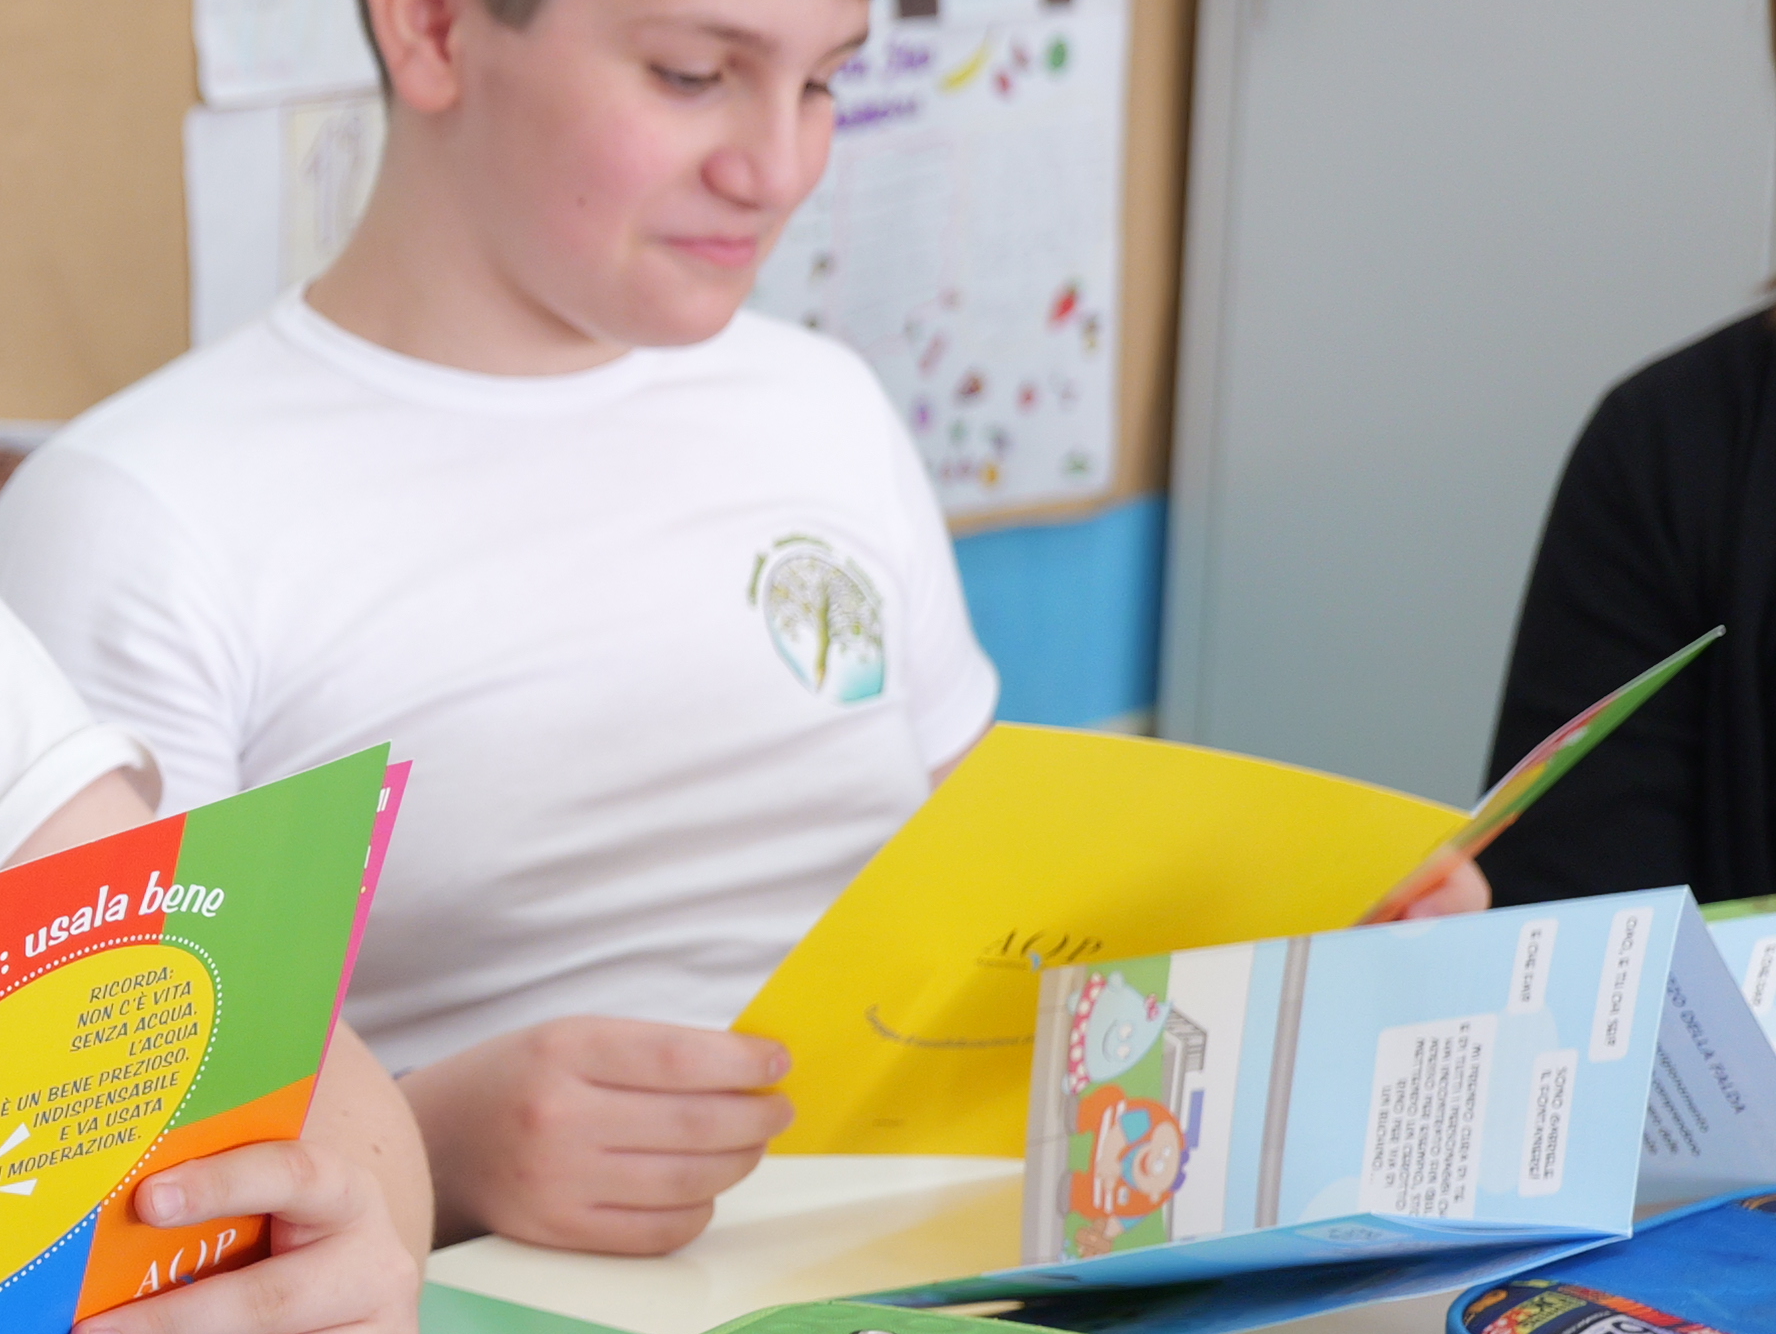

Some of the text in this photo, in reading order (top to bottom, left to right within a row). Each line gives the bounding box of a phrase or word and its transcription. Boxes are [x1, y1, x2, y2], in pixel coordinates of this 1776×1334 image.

[24, 882, 131, 960] usala
[138, 869, 226, 921] bene
[77, 1003, 114, 1029] NON
[153, 981, 192, 1005] VITA
[89, 967, 174, 1003] RICORDA:
[70, 1022, 128, 1052] SENZA
[129, 1022, 198, 1056] L'ACQUA
[0, 1098, 11, 1117] È
[17, 1090, 42, 1112] UN
[48, 1076, 94, 1101] BENE
[33, 1071, 181, 1128] INDISPENSABILE
[1550, 1066, 1568, 1110] SONO
[60, 1098, 163, 1141] E VA USATA
[7, 1126, 141, 1178] MODERAZIONE.
